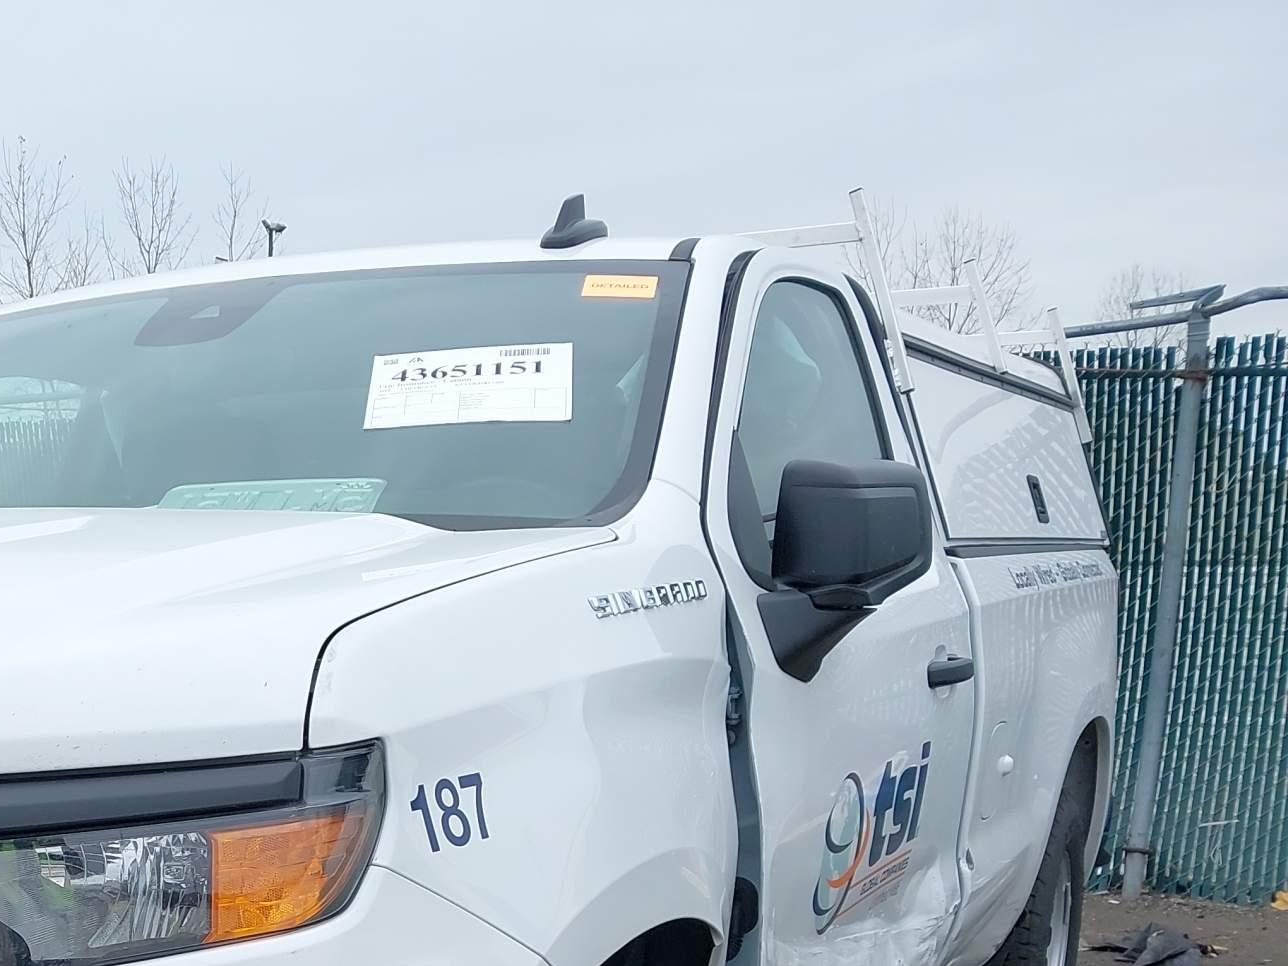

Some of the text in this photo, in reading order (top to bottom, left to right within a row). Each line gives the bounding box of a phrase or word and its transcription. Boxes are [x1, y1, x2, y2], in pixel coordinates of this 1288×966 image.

[591, 282, 650, 290] DETAILED
[392, 360, 543, 382] 43651151
[410, 772, 490, 853] 187
[868, 740, 933, 868] tsi
